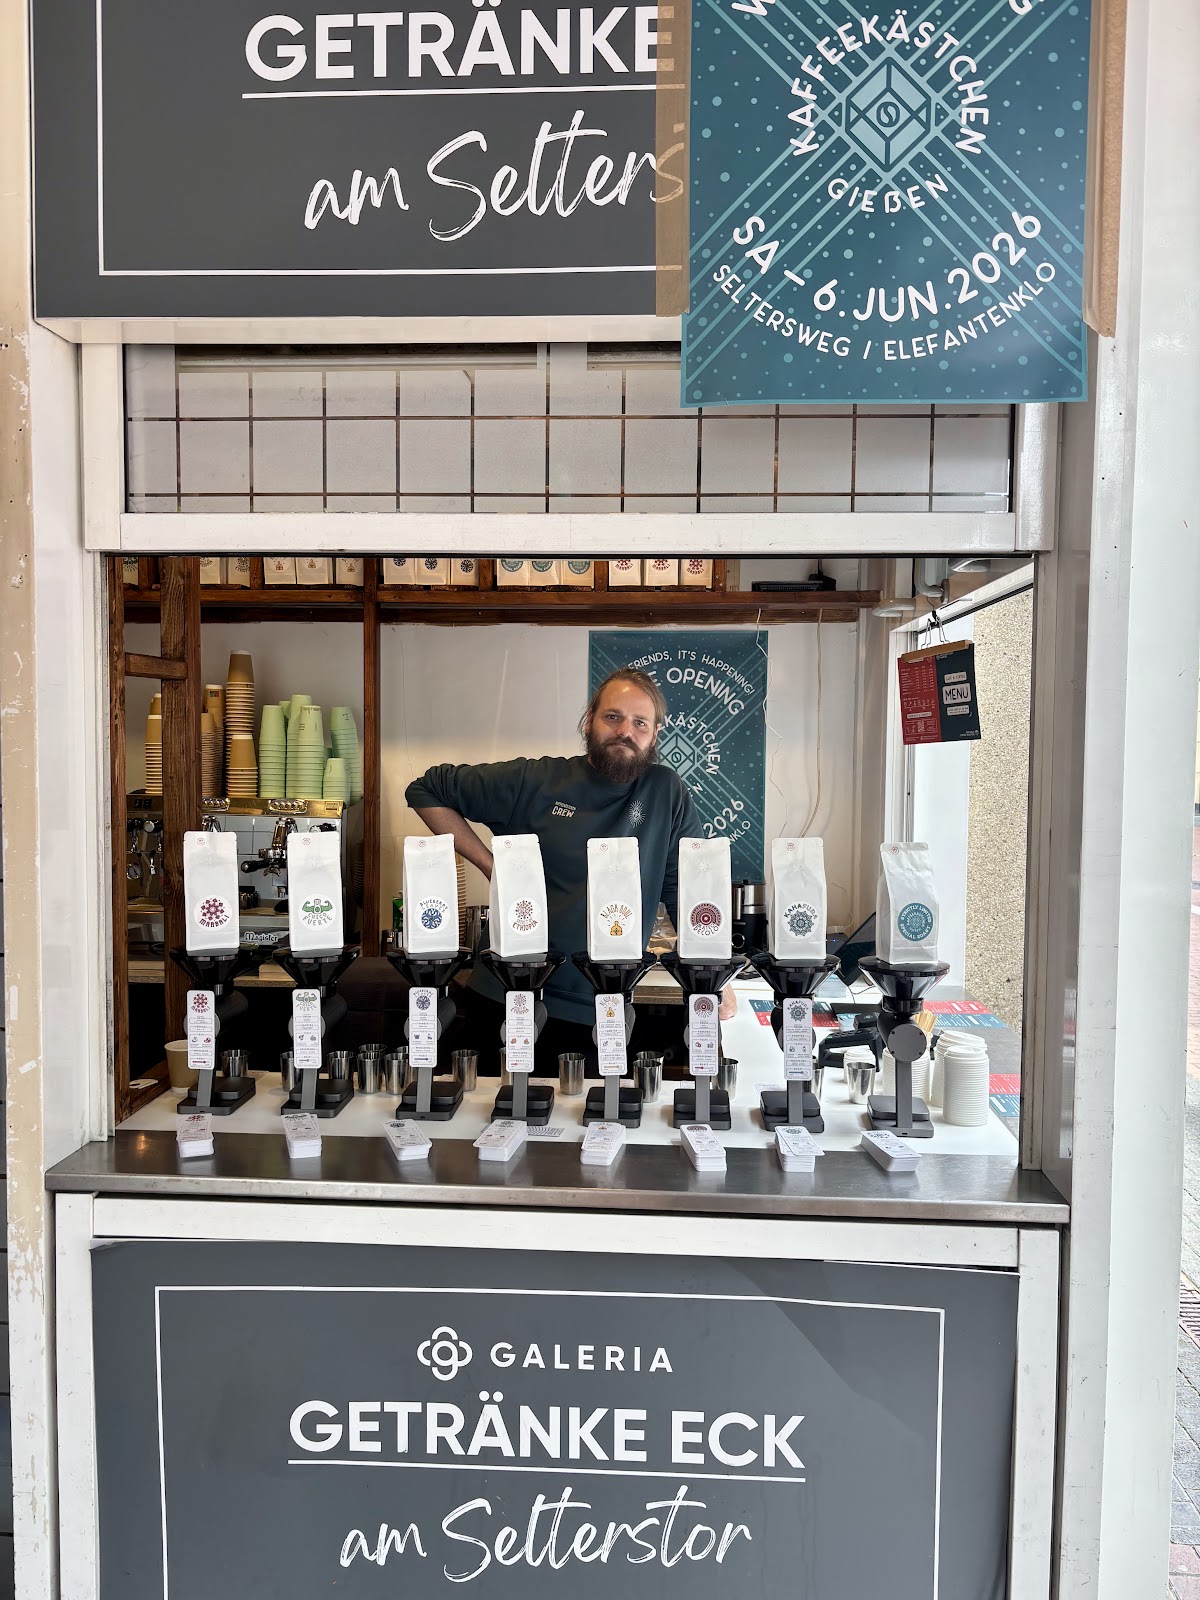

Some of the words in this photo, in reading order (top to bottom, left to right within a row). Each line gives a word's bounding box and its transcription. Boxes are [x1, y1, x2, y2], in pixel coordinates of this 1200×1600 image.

[245, 0, 675, 82] GETRÄNKE
[787, 9, 990, 157] KAFFEEKÄSTCHEN
[304, 166, 410, 230] am
[426, 109, 685, 242] Selters
[732, 215, 780, 275] SA
[713, 264, 852, 358] SELTERSWEG
[862, 340, 872, 361] /
[884, 262, 1056, 361] ELEFANTENKLO
[666, 667, 745, 716] OPENING
[678, 650, 696, 661] IT'S
[701, 654, 756, 696] HAPPENING!
[945, 686, 969, 702] MENU
[660, 711, 721, 776] KÄSTCHEN
[551, 805, 575, 818] CREW
[702, 798, 745, 839] 2026
[302, 915, 333, 926] FUERTE
[512, 920, 539, 931] ETHIOPIA
[490, 1341, 675, 1373] GALERIA
[288, 1389, 648, 1463] GETRÄNKE
[671, 1409, 807, 1469] ECK
[338, 1519, 426, 1570] am
[441, 1485, 753, 1584] Selterstor
